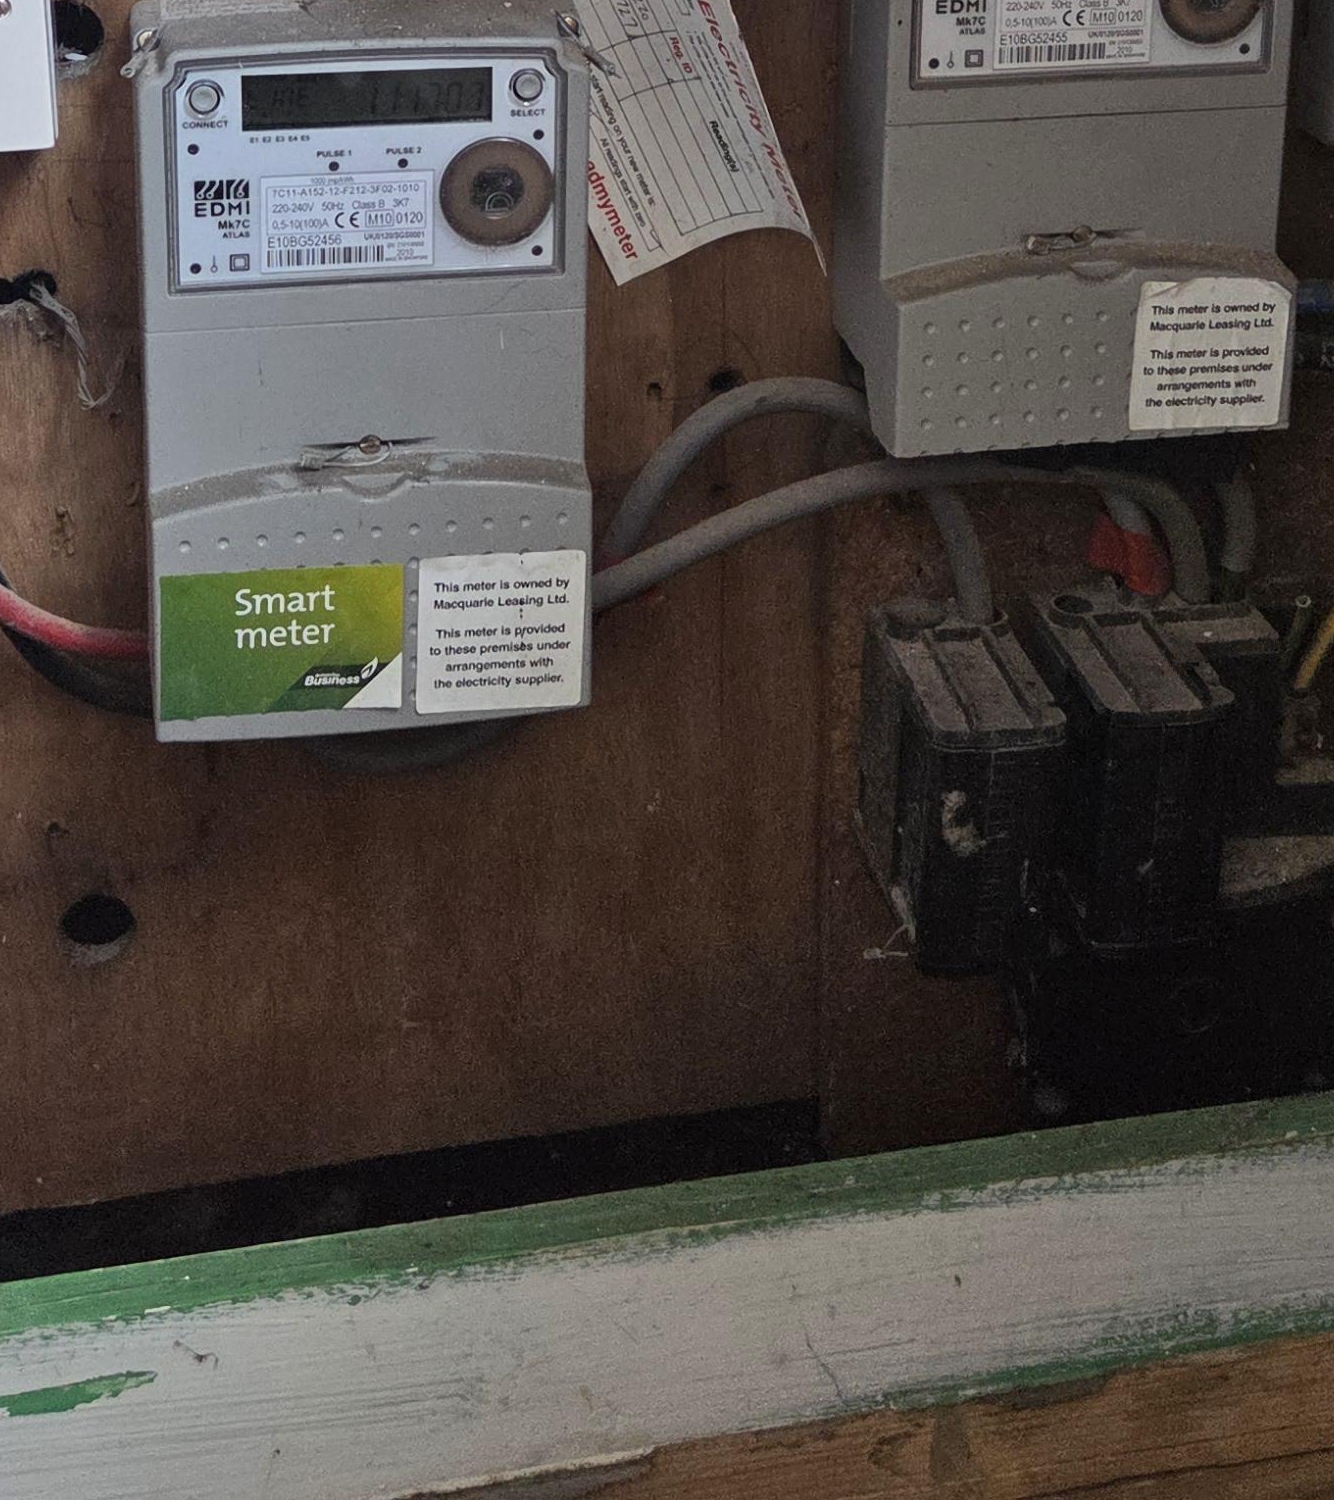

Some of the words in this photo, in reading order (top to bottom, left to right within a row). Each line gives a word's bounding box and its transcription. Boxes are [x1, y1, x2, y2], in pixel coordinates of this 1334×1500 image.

[956, 16, 986, 26] Mk7C
[1092, 11, 1115, 22] M10
[1118, 10, 1143, 22] 0120
[959, 28, 986, 36] ATLAS
[999, 32, 1068, 46] E10BG52455
[510, 108, 546, 117] SELECT
[182, 120, 229, 130] CONNECT
[385, 147, 414, 155] PULSE
[709, 120, 740, 173] Reading(s)
[317, 150, 345, 158] PULSE
[194, 201, 250, 218] EDMI
[272, 202, 314, 214] 220-240V
[321, 202, 345, 211] 50Hz
[352, 200, 376, 210] Class
[393, 198, 409, 208] 3K7
[218, 219, 250, 230] Mk7C
[368, 213, 393, 225] M10
[396, 212, 423, 224] 0120
[268, 234, 342, 248] E10BG52456
[1152, 305, 1175, 315] This
[1178, 304, 1209, 314] meter
[1211, 304, 1221, 313] is
[1224, 303, 1259, 312] owned
[1263, 302, 1276, 314] by
[1150, 321, 1205, 334] Macquarie
[1209, 320, 1251, 331] Leasing
[1254, 318, 1274, 328] Ltd.
[1150, 350, 1174, 360] This
[1176, 348, 1207, 358] meter
[1209, 348, 1219, 358] is
[1222, 346, 1269, 359] provided
[1143, 366, 1154, 376] to
[1157, 364, 1186, 375] these
[1189, 363, 1239, 376] premises
[1241, 362, 1273, 372] under
[1157, 380, 1231, 392] arrangements
[1235, 378, 1257, 388] with
[1145, 398, 1163, 408] the
[1165, 396, 1218, 408] electricity
[1220, 394, 1265, 406] supplier.
[434, 582, 459, 592] This
[463, 582, 496, 592] meter
[500, 580, 509, 590] is
[513, 578, 552, 589] owned
[556, 577, 570, 590] by
[235, 584, 335, 616] Smart
[434, 598, 494, 611] Macquarie
[498, 596, 543, 608] Leasing
[547, 594, 569, 604] Ltd.
[235, 619, 335, 650] meter
[436, 628, 461, 640] This
[464, 627, 497, 638] meter
[501, 626, 511, 636] is
[515, 623, 565, 637] provided
[429, 646, 441, 656] to
[445, 644, 476, 656] these
[480, 642, 533, 656] premises
[537, 640, 571, 650] under
[445, 660, 527, 672] arrangements
[530, 657, 553, 668] with
[304, 675, 360, 687] Business
[434, 679, 452, 689] the
[455, 676, 511, 688] electricity
[515, 674, 563, 686] supplier.
